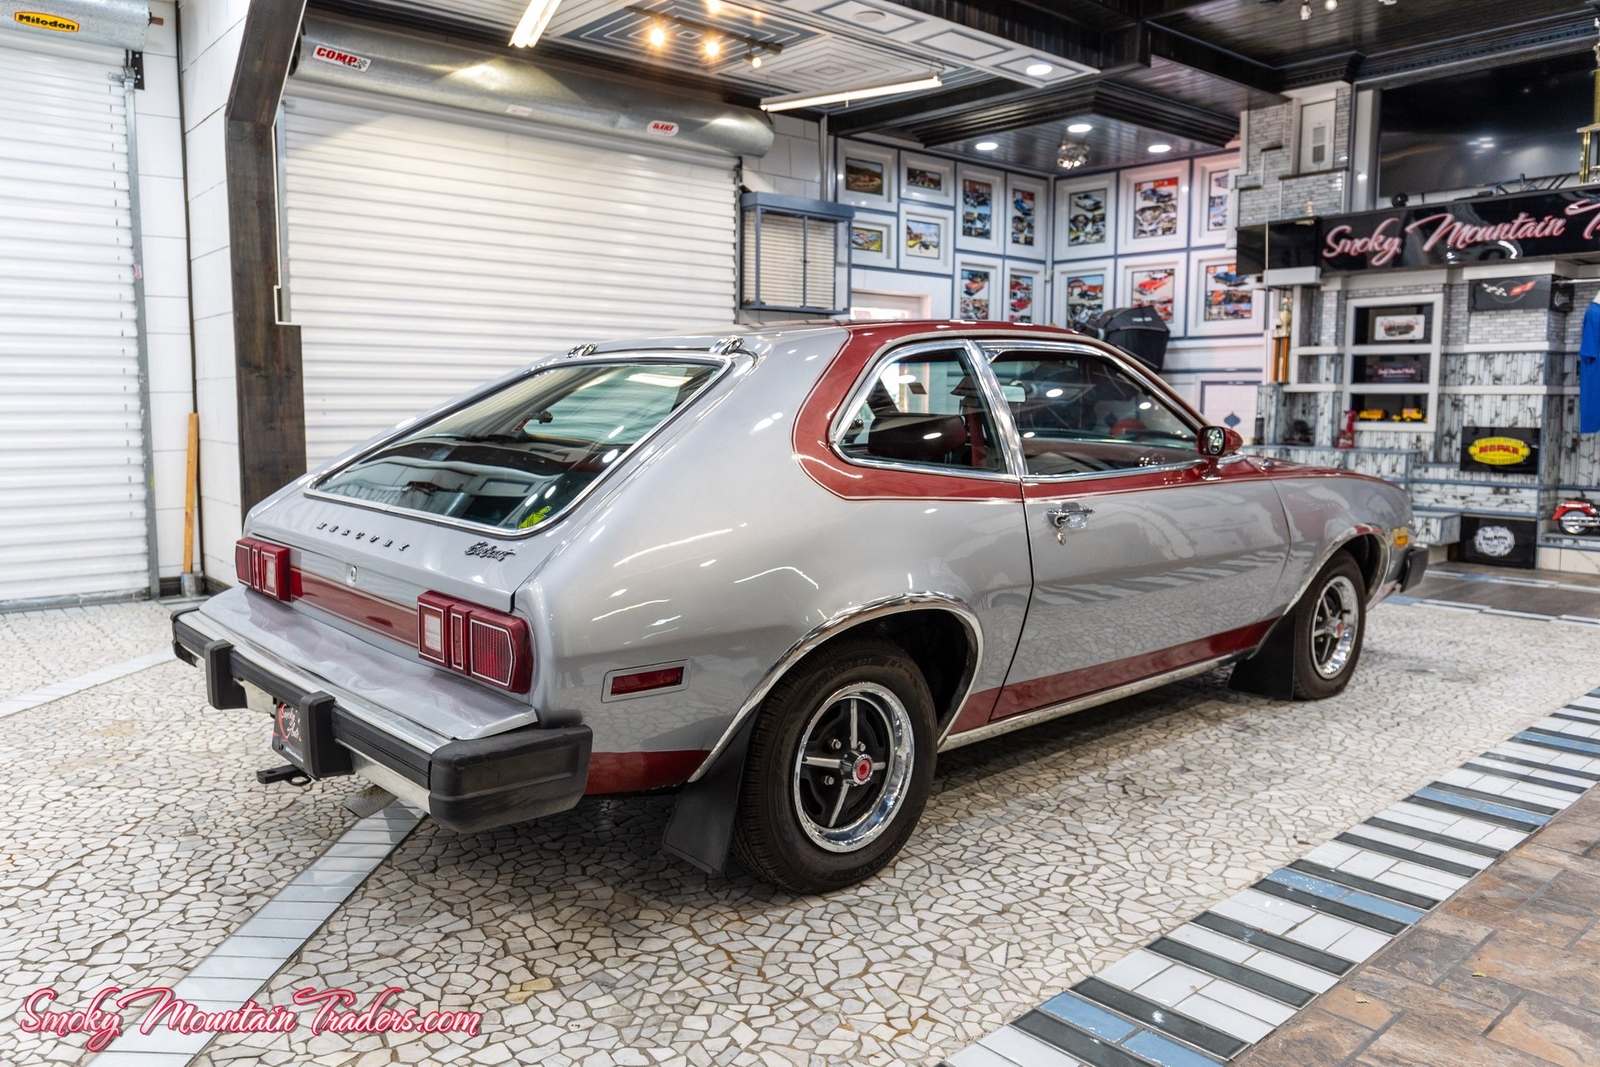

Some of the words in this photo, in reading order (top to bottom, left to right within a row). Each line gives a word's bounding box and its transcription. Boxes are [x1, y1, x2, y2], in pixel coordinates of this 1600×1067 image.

[18, 14, 75, 31] Milodon
[316, 47, 358, 65] COMP
[1322, 218, 1402, 266] Smoky
[1404, 212, 1566, 251] Mountain
[317, 522, 410, 552] MERCURY
